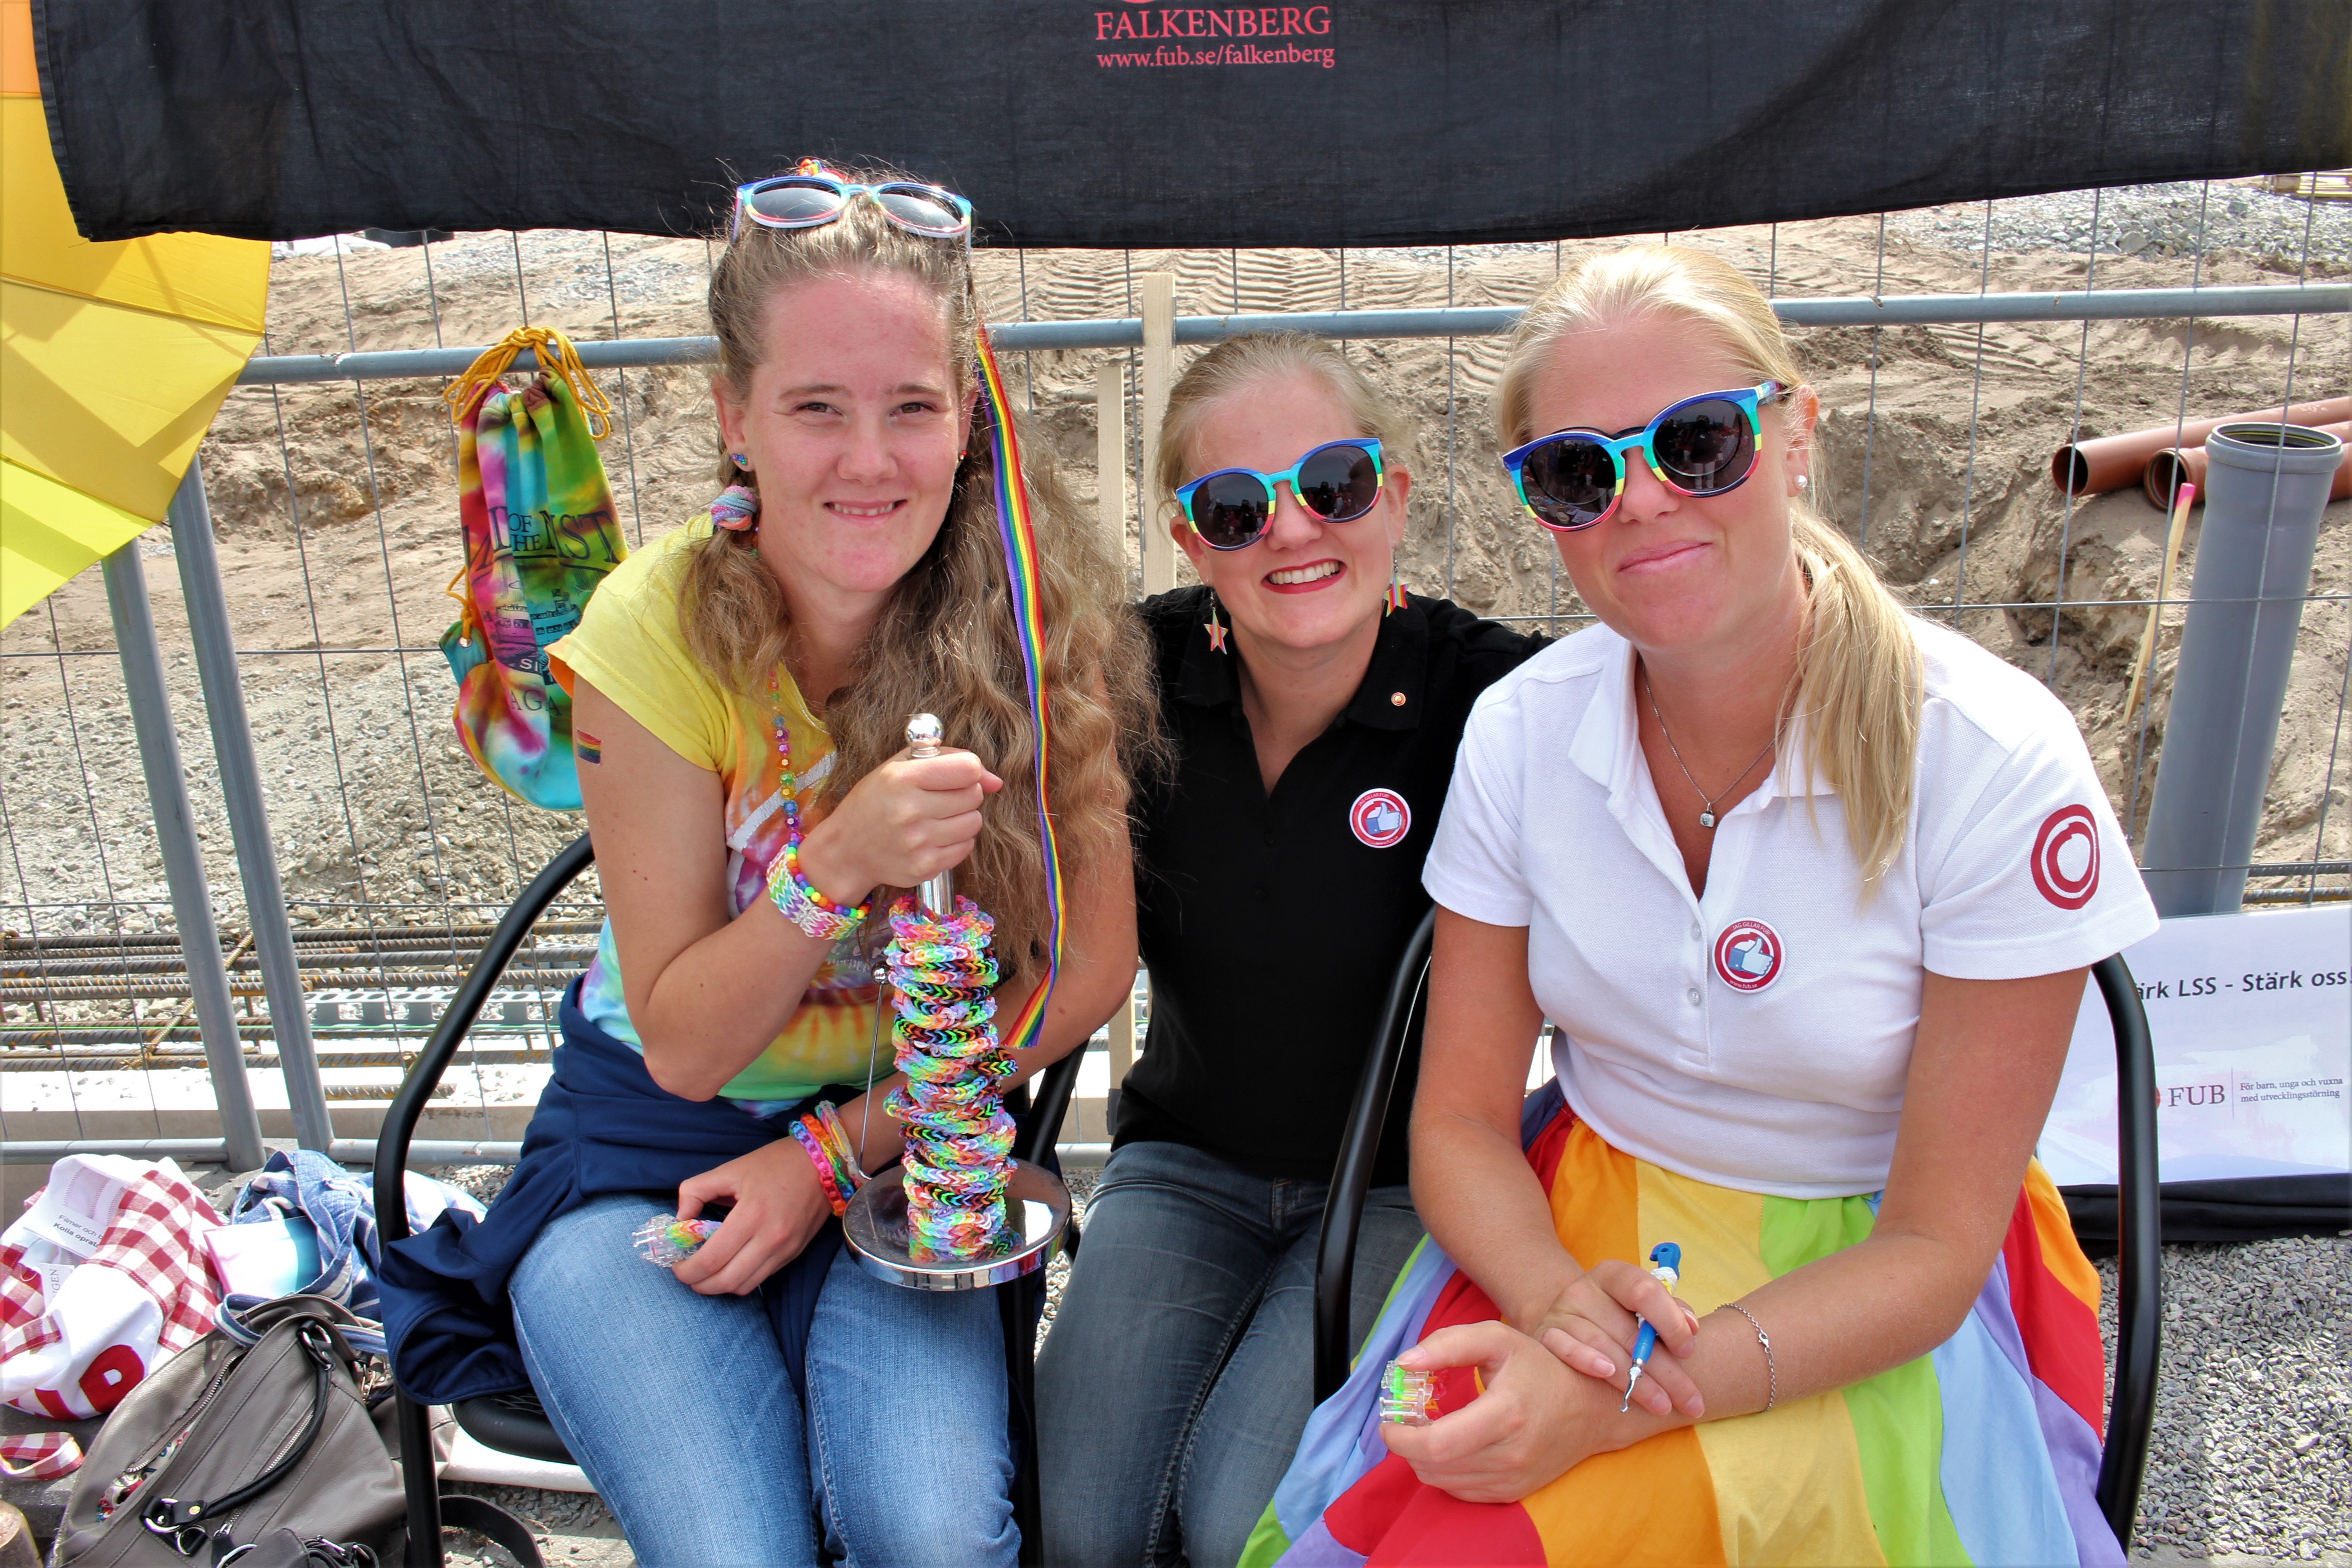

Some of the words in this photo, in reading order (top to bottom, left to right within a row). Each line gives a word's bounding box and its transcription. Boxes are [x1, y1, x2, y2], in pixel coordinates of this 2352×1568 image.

[1095, 6, 1332, 40] FALKENBERG
[1097, 43, 1335, 69] www.fub.se/falkenberg
[508, 513, 532, 532] OF
[1760, 926, 1772, 936] FUB!
[1730, 980, 1758, 989] www.fub.se
[2178, 976, 2216, 997] LSS
[2242, 970, 2303, 992] Stärk
[2240, 1083, 2254, 1091] För
[2256, 1082, 2277, 1090] barn,
[2301, 1078, 2316, 1086] och
[2167, 1084, 2225, 1107] FUB
[2240, 1094, 2259, 1102] med
[2260, 1090, 2340, 1101] utvecklingsstörning
[53, 1222, 74, 1235] Kolla
[58, 1215, 83, 1229] Filmer
[83, 1227, 97, 1236] och
